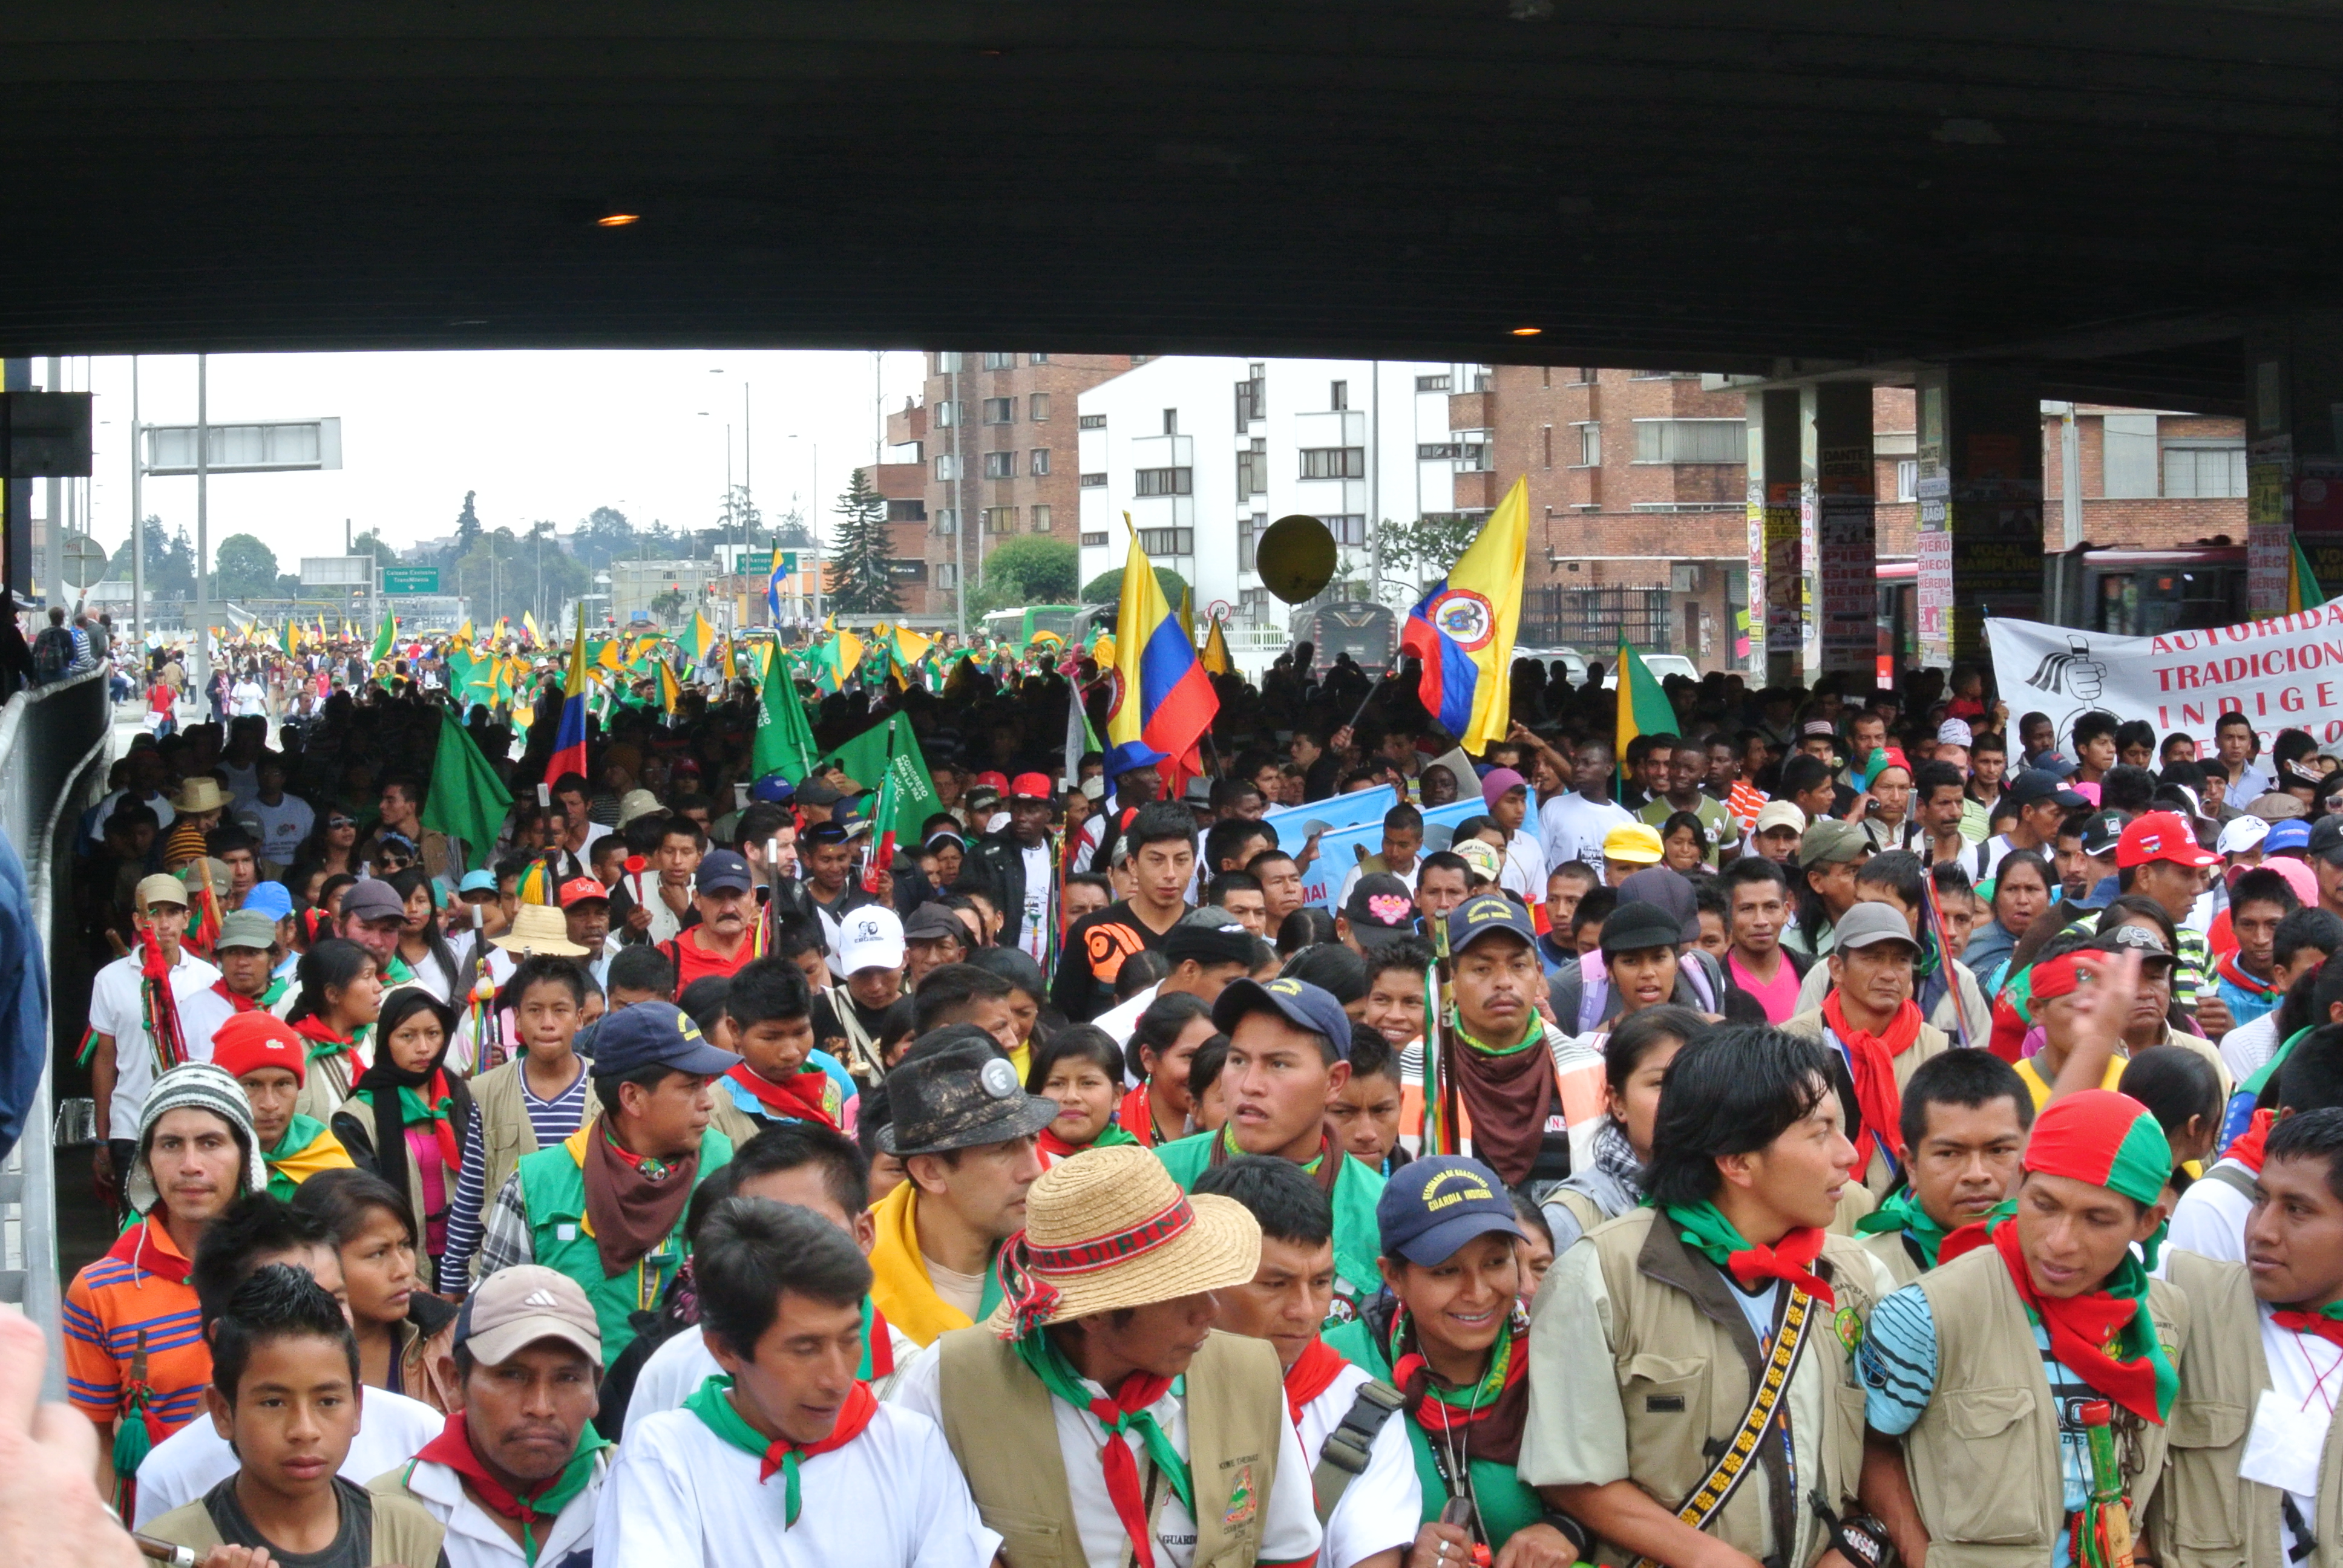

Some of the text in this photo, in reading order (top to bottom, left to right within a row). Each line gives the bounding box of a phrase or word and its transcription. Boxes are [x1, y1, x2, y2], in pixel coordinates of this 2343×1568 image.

[1918, 540, 1950, 552] PIERO
[1918, 559, 1950, 570] GIECO
[1919, 578, 1951, 589] HEREDIA
[2152, 639, 2343, 693] TRADICION
[2158, 682, 2338, 730] INDIGE
[894, 757, 923, 802] PARA LA PAZ
[901, 754, 929, 797] CONGRESO
[1427, 1192, 1463, 1212] GUARDIA
